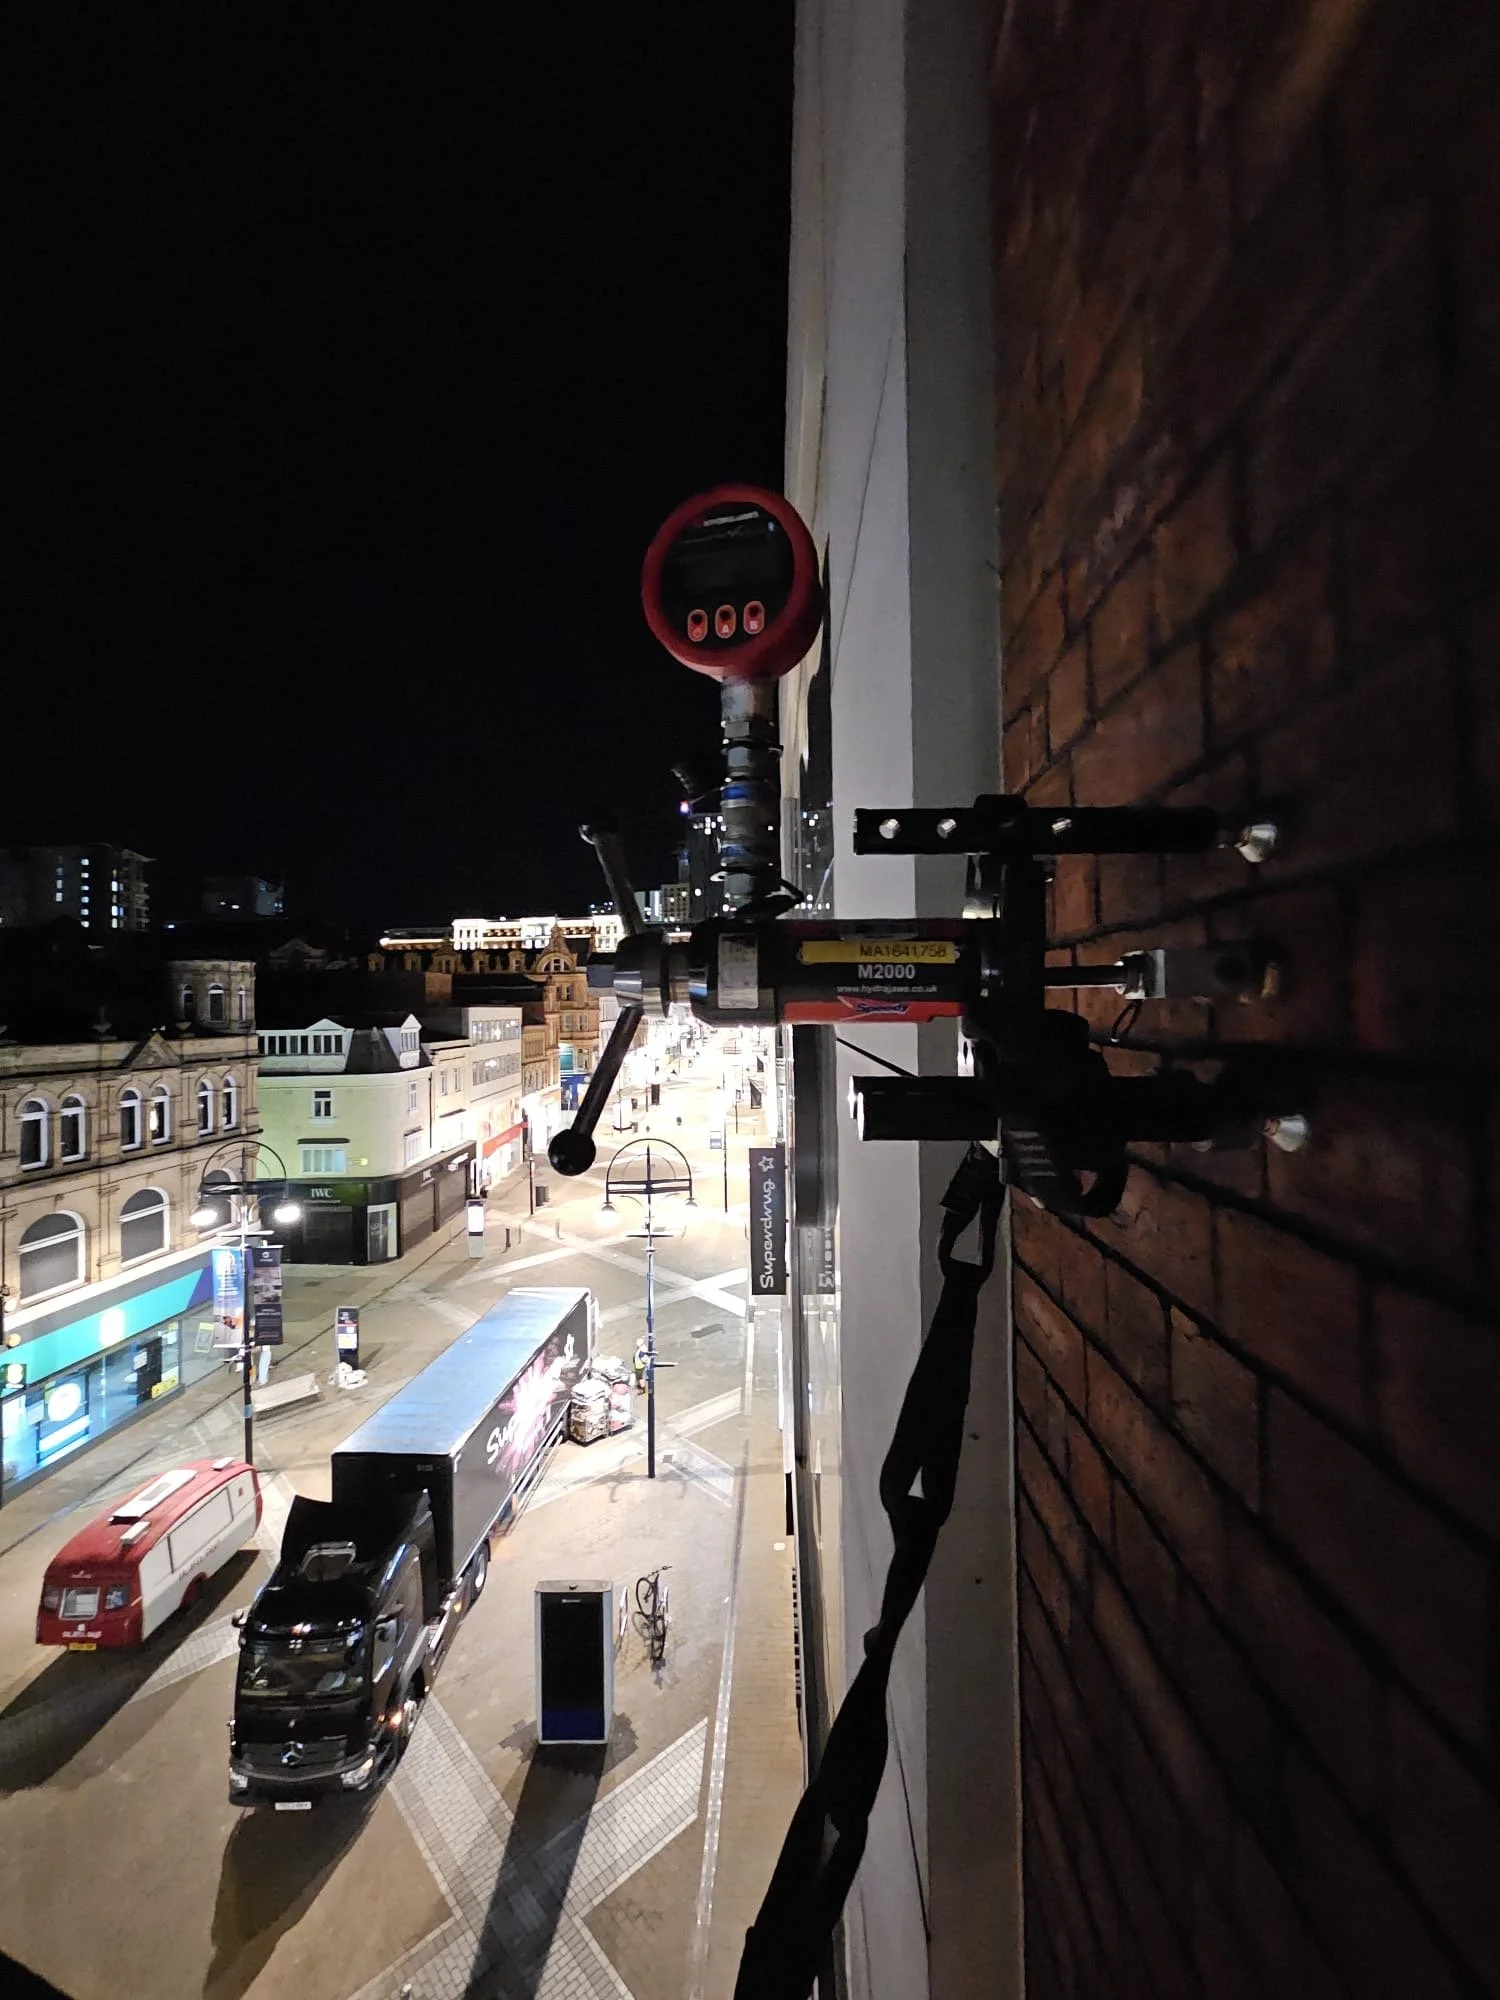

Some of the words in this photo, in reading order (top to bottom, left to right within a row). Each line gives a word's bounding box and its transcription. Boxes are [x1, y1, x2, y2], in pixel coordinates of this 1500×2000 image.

[859, 944, 947, 958] MA1641758
[857, 964, 916, 980] M2000
[311, 1187, 333, 1199] IWC
[760, 1178, 776, 1289] Superdrug
